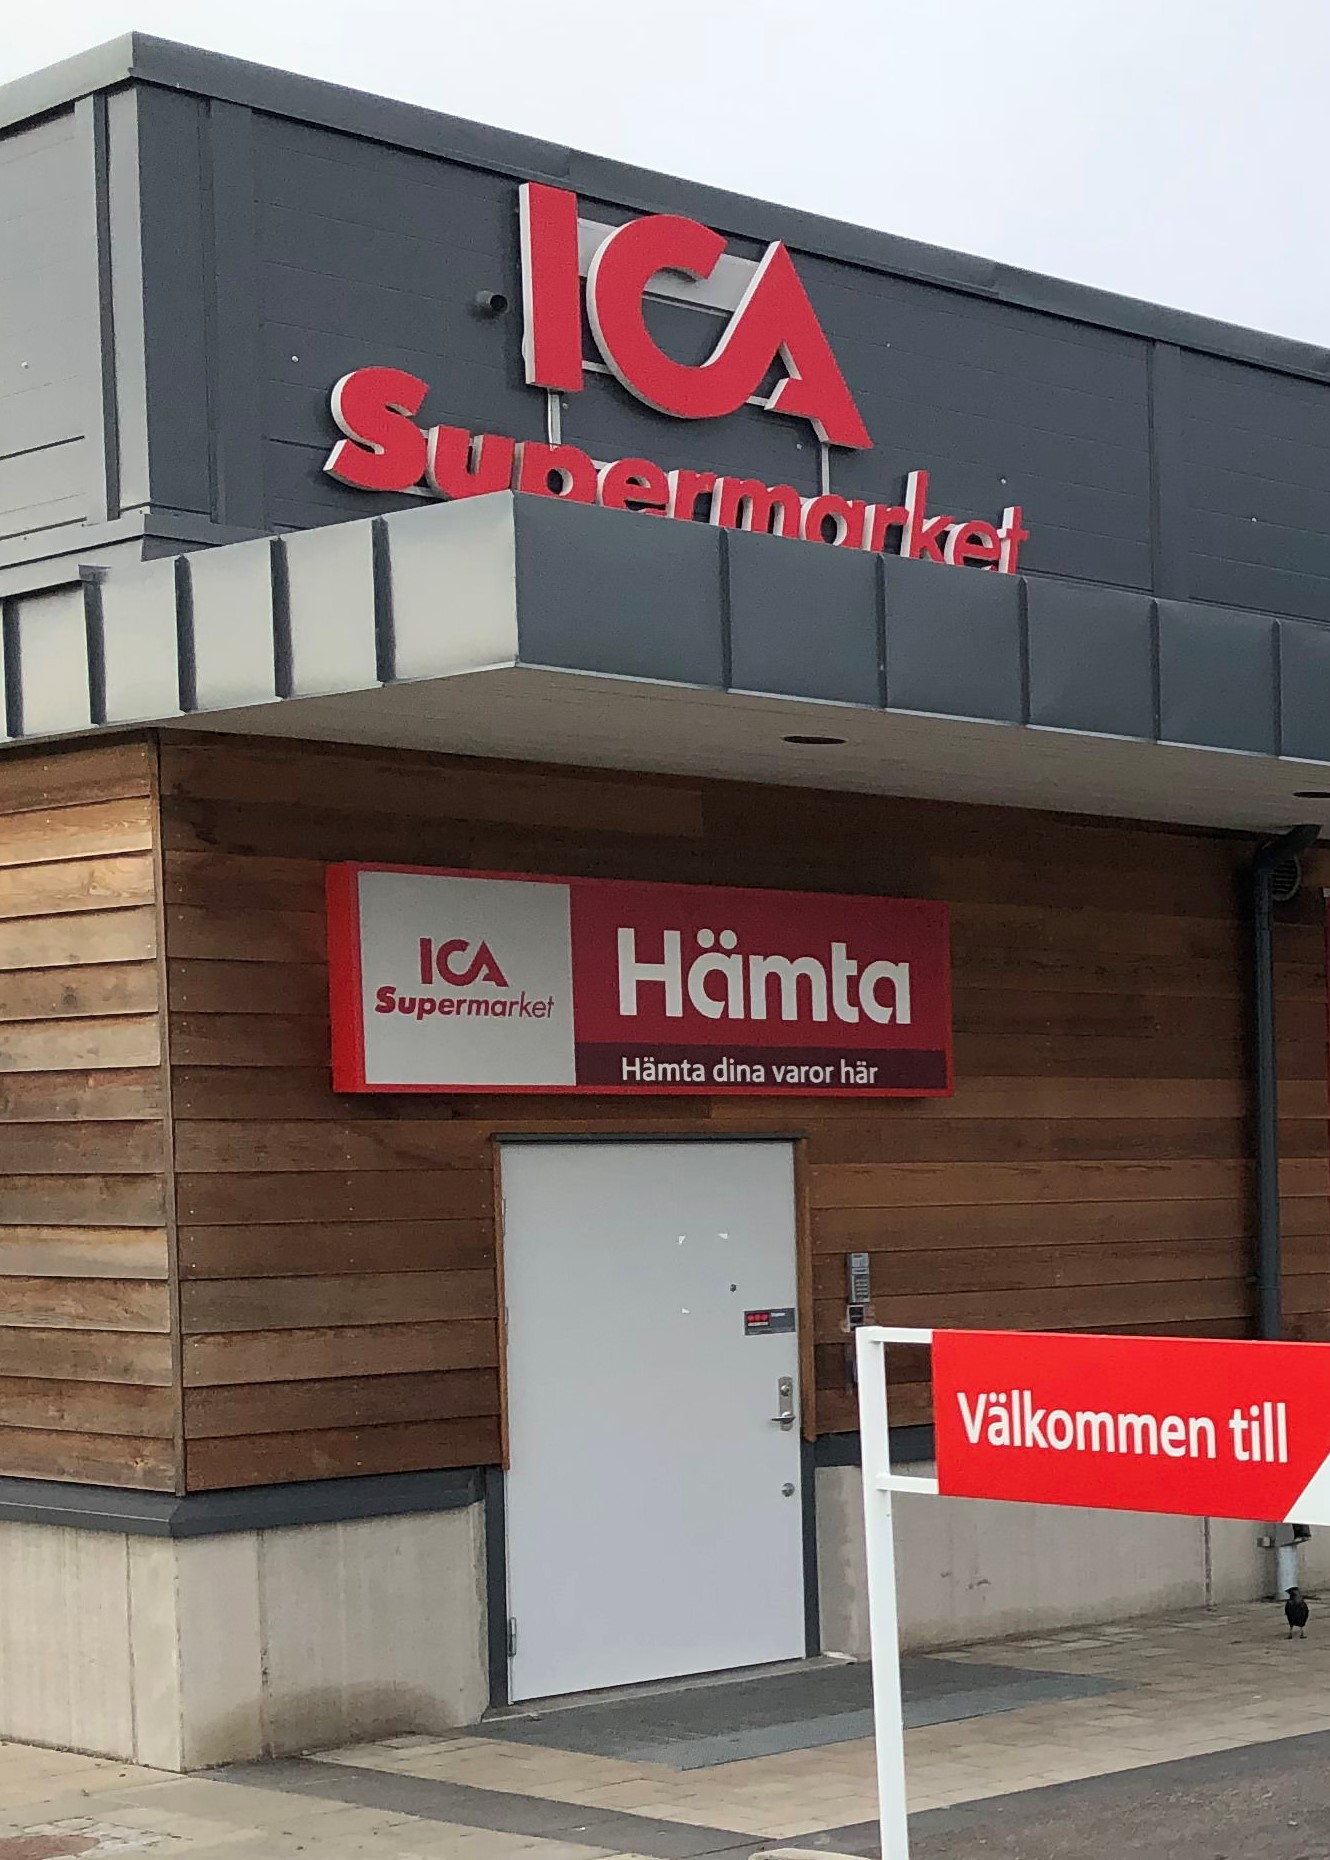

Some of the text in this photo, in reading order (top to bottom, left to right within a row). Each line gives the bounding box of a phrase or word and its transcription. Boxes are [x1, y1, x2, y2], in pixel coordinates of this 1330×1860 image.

[519, 182, 873, 449] ICA
[419, 937, 509, 987] ICA
[617, 927, 911, 1024] Hämta
[375, 985, 555, 1020] Supermarket
[622, 1056, 878, 1084] Hämta dina varor här
[956, 1388, 1289, 1464] Välkommen till
